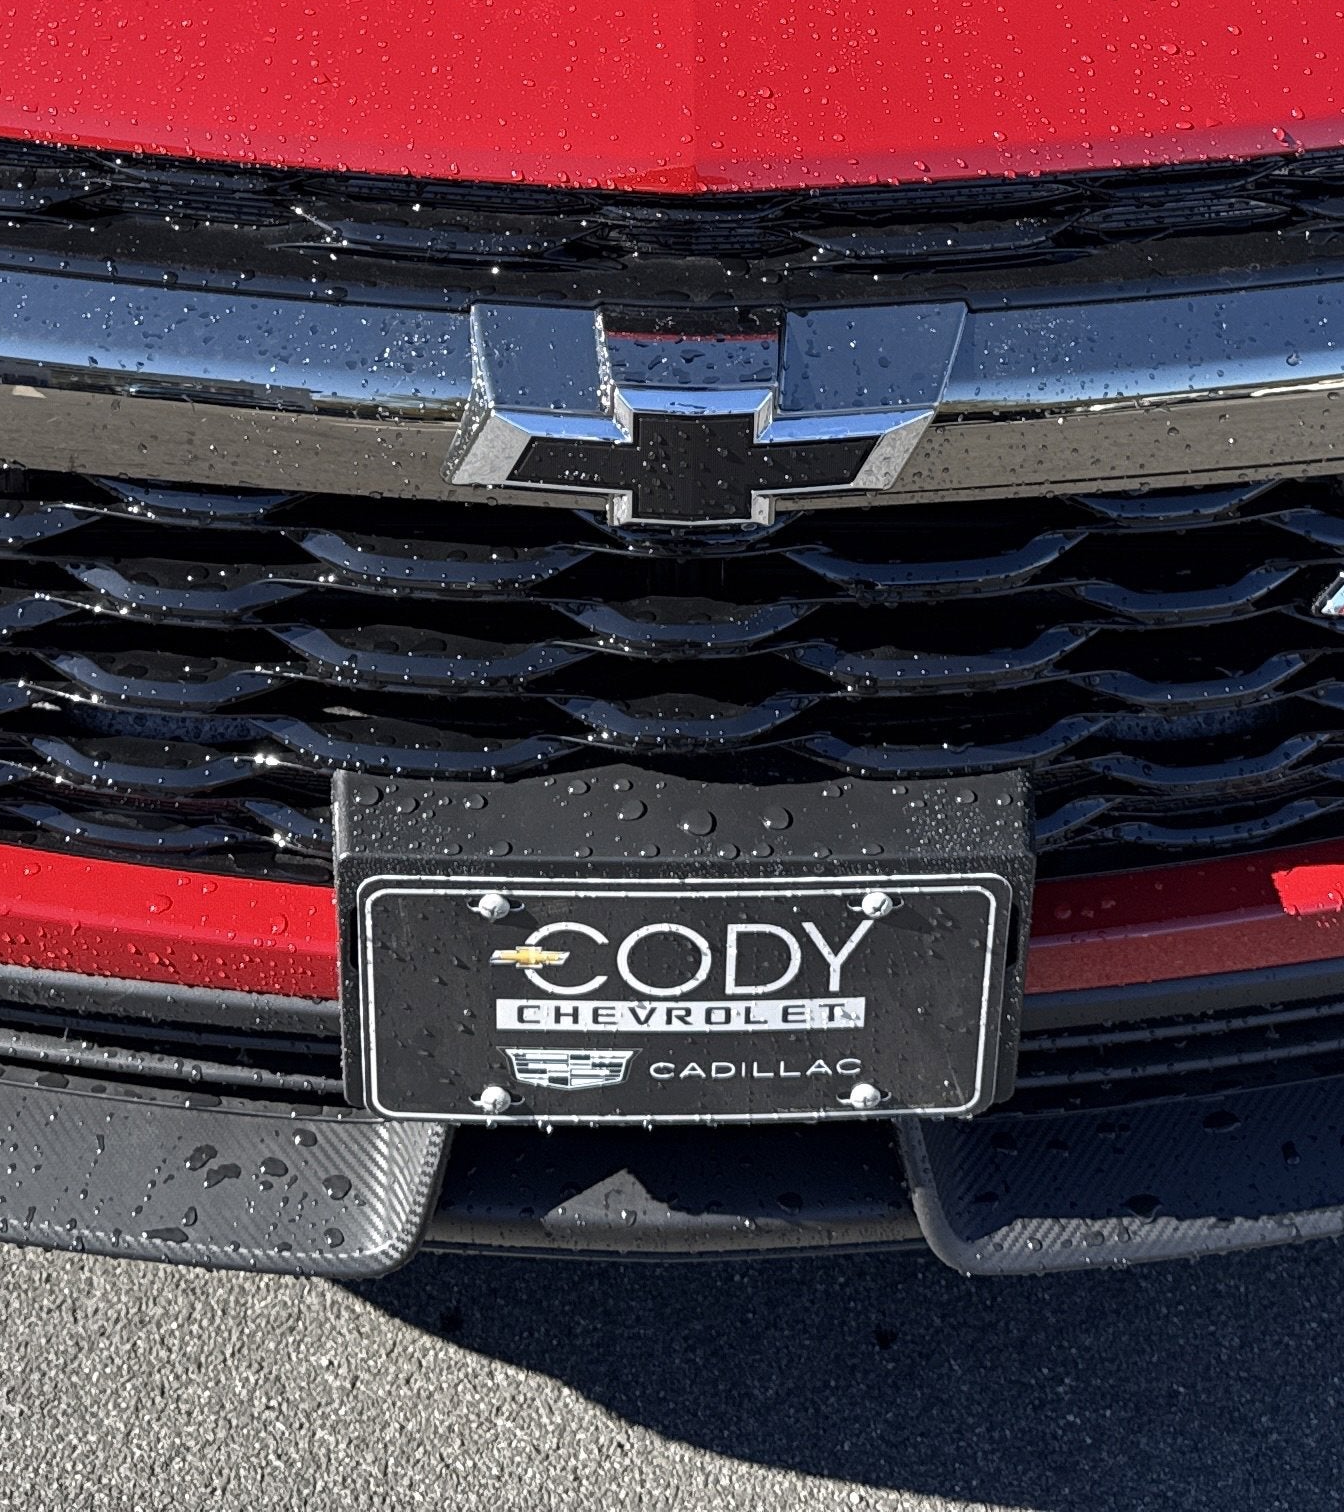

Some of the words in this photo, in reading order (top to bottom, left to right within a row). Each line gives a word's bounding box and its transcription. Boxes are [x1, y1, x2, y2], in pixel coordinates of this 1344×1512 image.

[523, 920, 875, 995] CODY
[517, 1003, 847, 1025] CHEVROLET
[649, 1058, 863, 1079] CADILLAC
